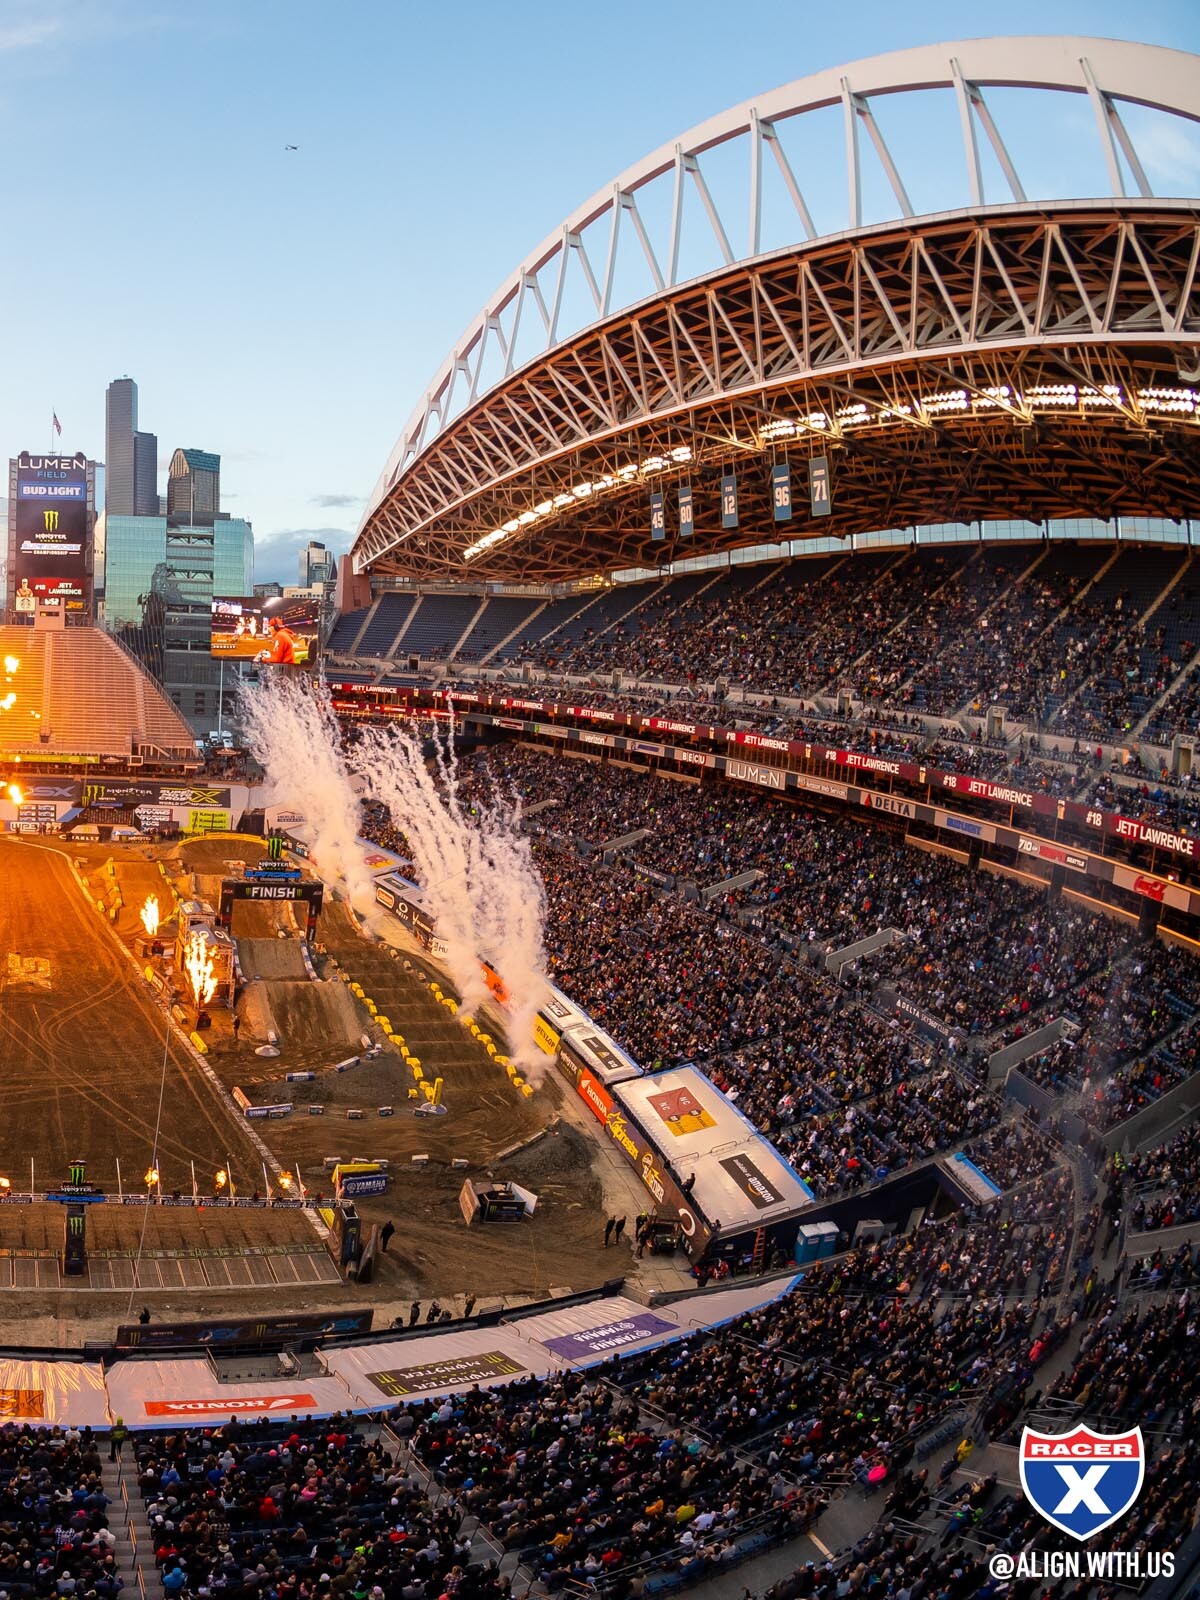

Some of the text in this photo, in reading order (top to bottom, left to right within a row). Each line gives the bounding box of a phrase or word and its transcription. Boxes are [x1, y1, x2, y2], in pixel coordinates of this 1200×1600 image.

[18, 458, 86, 470] LUMEN
[37, 471, 67, 479] FIELD
[22, 486, 81, 496] BUD LIGHT
[774, 486, 790, 507] 96
[813, 480, 828, 502] 71
[680, 505, 692, 524] 80
[723, 495, 736, 515] 12
[652, 511, 664, 529] 45
[351, 684, 365, 692] JETT
[365, 686, 397, 694] LAWRENCE
[458, 693, 479, 701] LAWRENCE
[522, 701, 543, 710] LAWRENCE
[580, 709, 591, 717] JETT
[591, 711, 615, 721] LAWRENCE
[656, 720, 669, 729] JETT
[669, 722, 696, 734] LAWRENCE
[584, 735, 605, 745] verizon
[726, 732, 789, 751] #18 JETT LAWRENCE
[825, 751, 900, 775] #18 JETT LAWRENCE
[728, 760, 780, 787] LUMEN
[106, 787, 153, 796] MONSTER
[943, 775, 1033, 807] #18 JETT LAWRENCE
[875, 796, 910, 817] DELTA
[1086, 811, 1194, 855] #18 JETT LAWRENCE
[1018, 838, 1085, 868] 710 SEATTLE
[252, 887, 296, 898] FINISH
[536, 1025, 556, 1048] DUNLOP
[586, 1085, 608, 1118] HONDA
[355, 1179, 386, 1191] YAMAHA
[748, 1176, 776, 1203] amazon
[572, 1323, 621, 1343] YAMAHA
[588, 1332, 637, 1352] YAMAHA
[400, 1360, 481, 1380] MONSTER
[412, 1370, 497, 1391] MONSTER
[164, 1399, 267, 1411] HONDA
